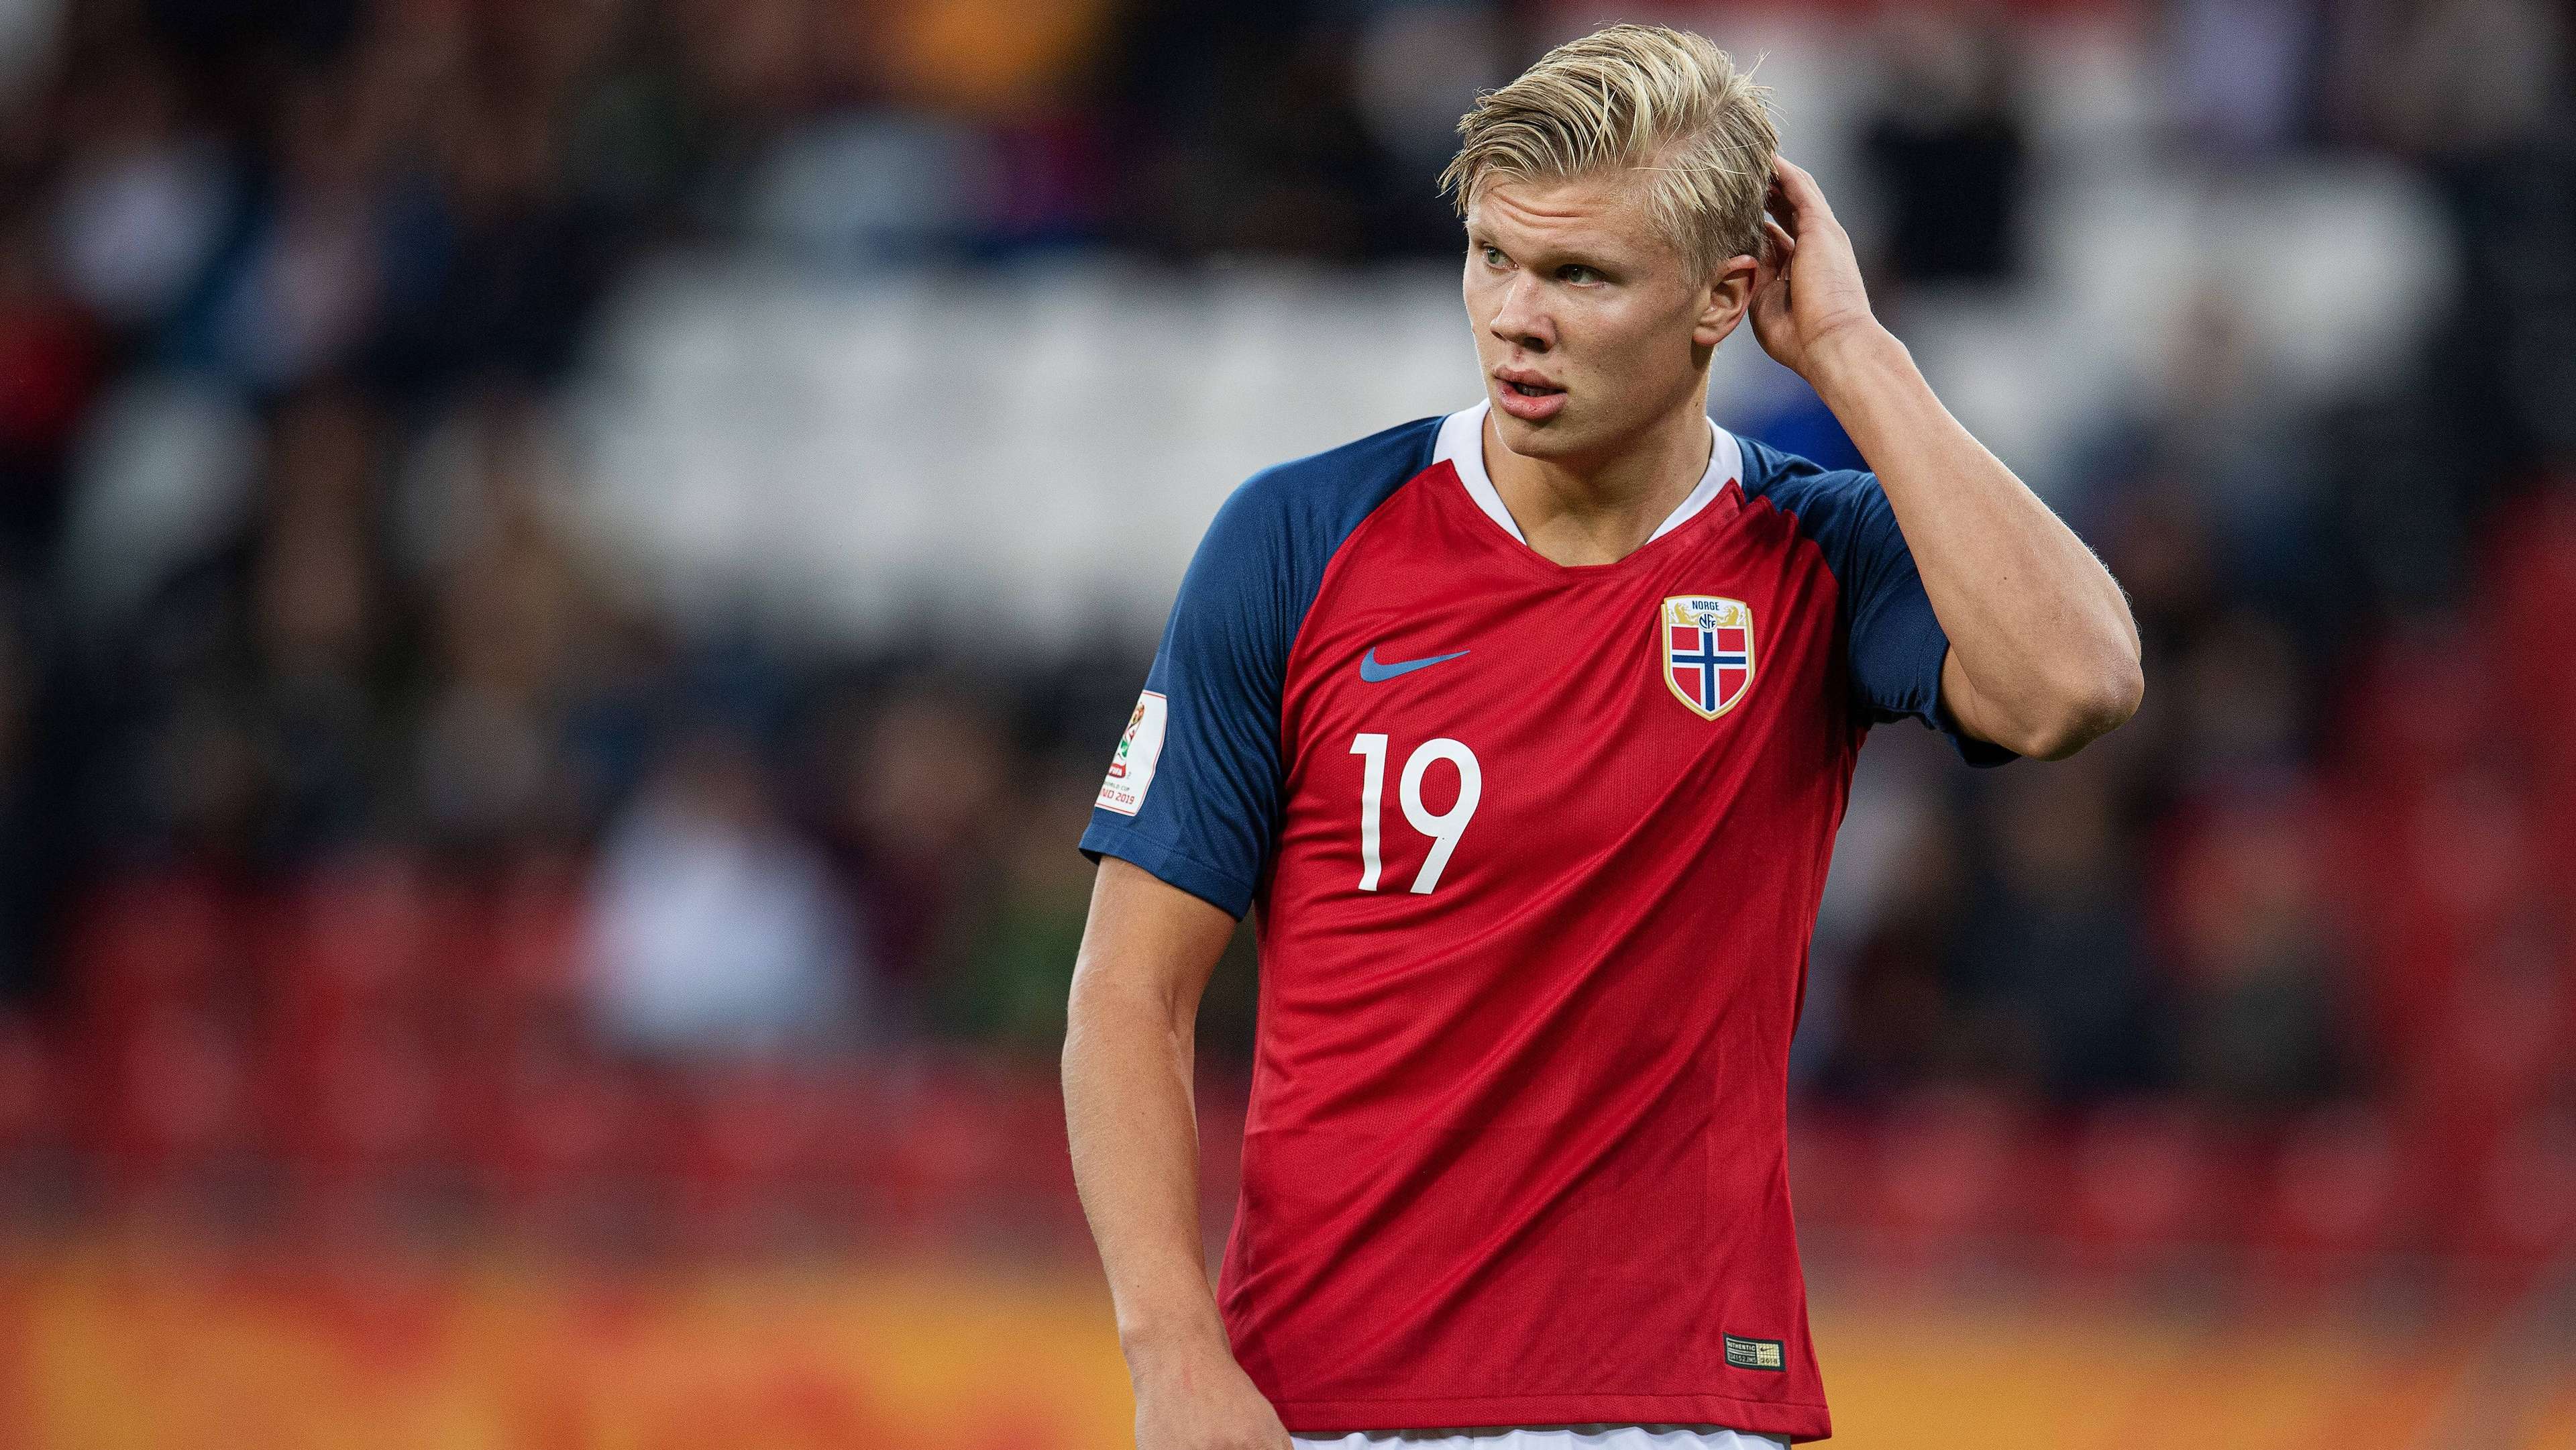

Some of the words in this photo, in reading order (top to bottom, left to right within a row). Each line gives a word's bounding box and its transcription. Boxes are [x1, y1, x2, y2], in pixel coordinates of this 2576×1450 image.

[1692, 601, 1719, 611] NORGE
[1101, 788, 1114, 799] ND
[1116, 792, 1135, 805] 2019
[1349, 733, 1482, 894] 19
